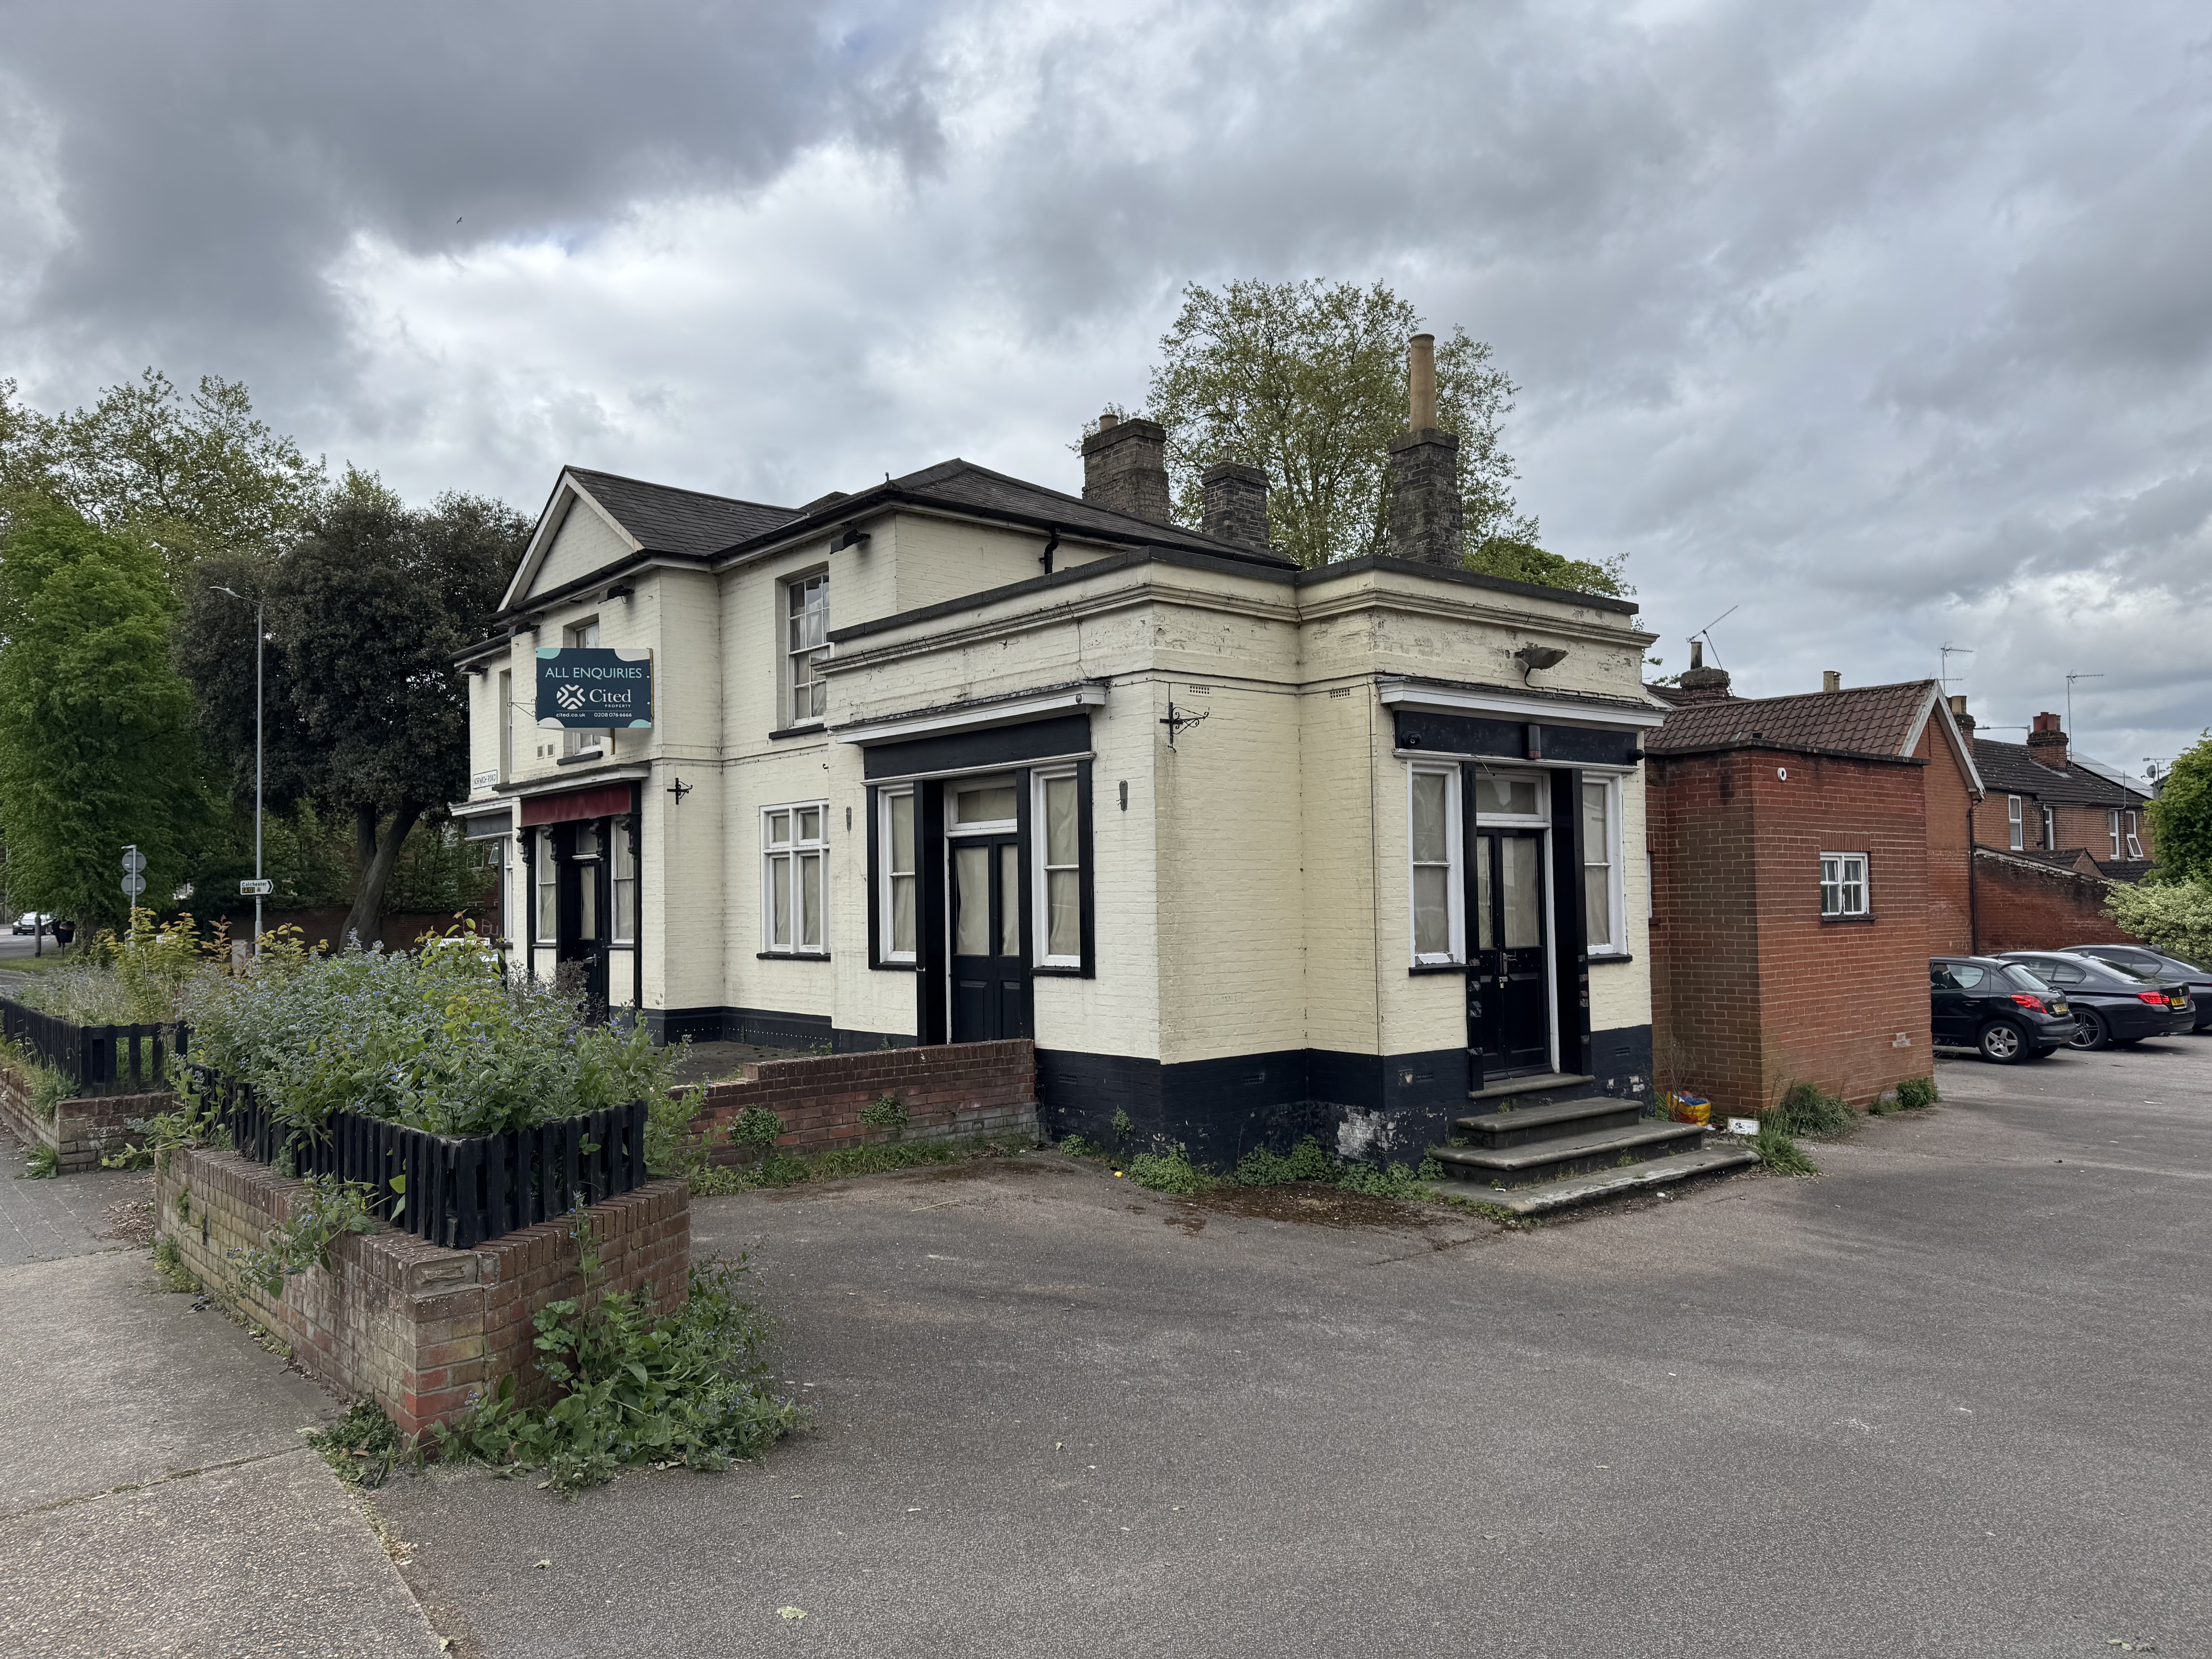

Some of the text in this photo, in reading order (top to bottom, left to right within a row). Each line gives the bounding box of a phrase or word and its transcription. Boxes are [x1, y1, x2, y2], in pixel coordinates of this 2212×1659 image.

[545, 667, 642, 680] ALL ENQUIRIES
[589, 689, 632, 702] Cited
